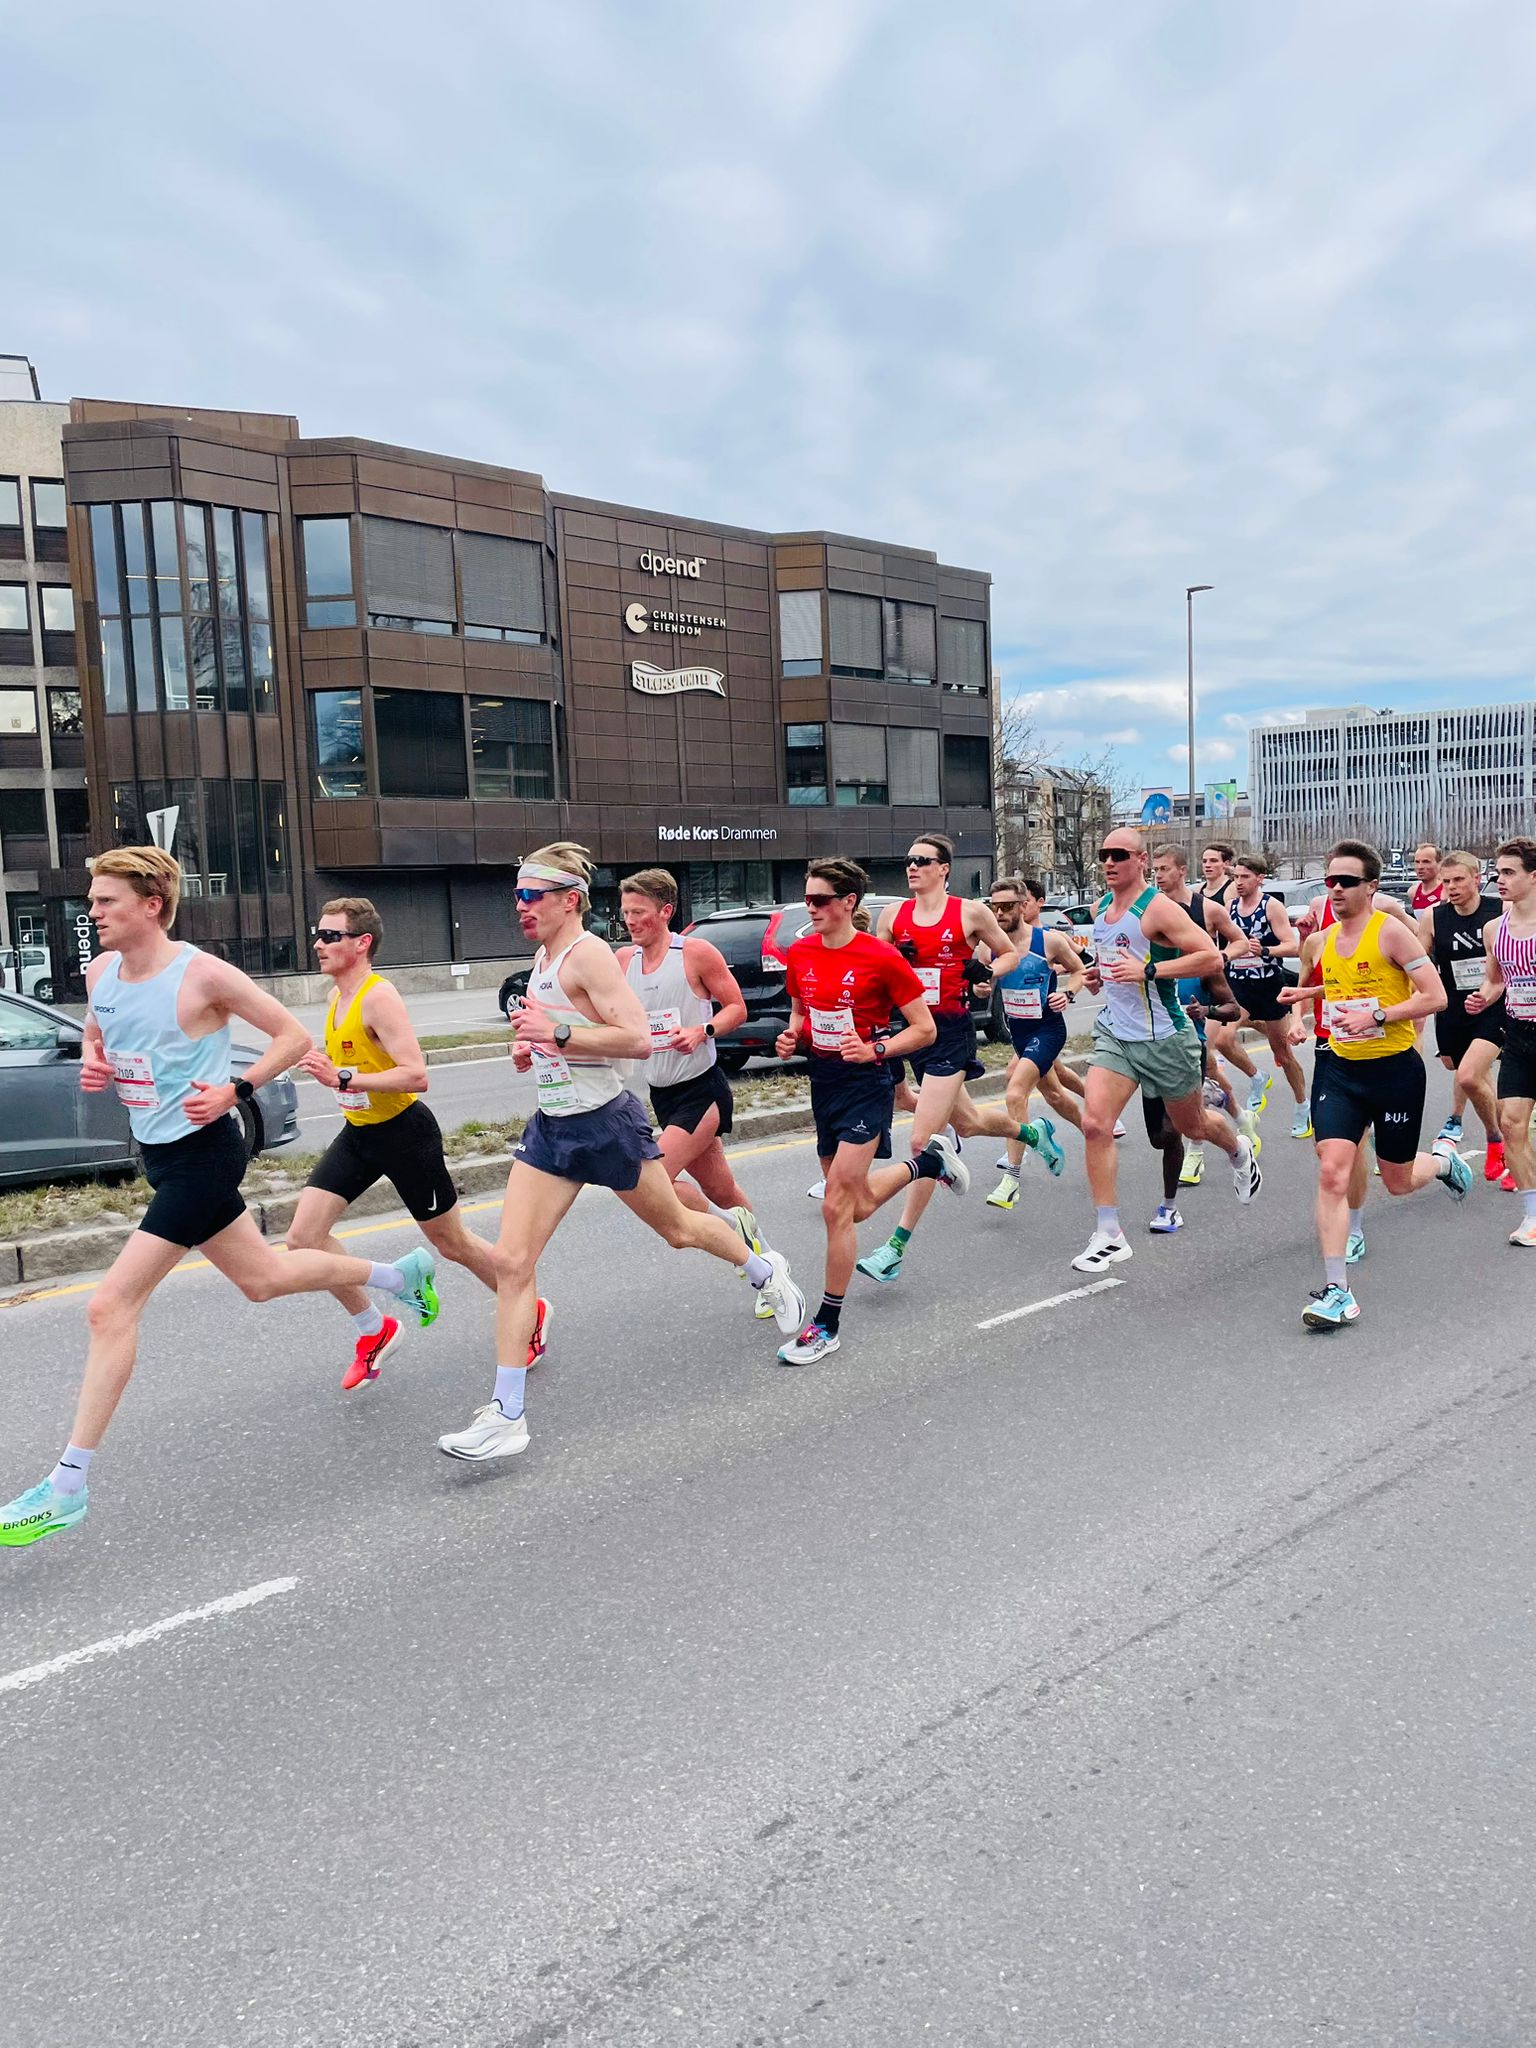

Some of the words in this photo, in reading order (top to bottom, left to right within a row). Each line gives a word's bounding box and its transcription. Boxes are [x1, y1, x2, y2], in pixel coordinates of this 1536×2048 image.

[652, 610, 726, 627] CHRISTENSEN
[653, 622, 701, 635] EIENDOM
[658, 826, 690, 840] Røde
[692, 826, 719, 840] Kors
[721, 826, 777, 840] Drammen
[1392, 852, 1401, 864] P
[3, 1510, 53, 1531] BROOKS
